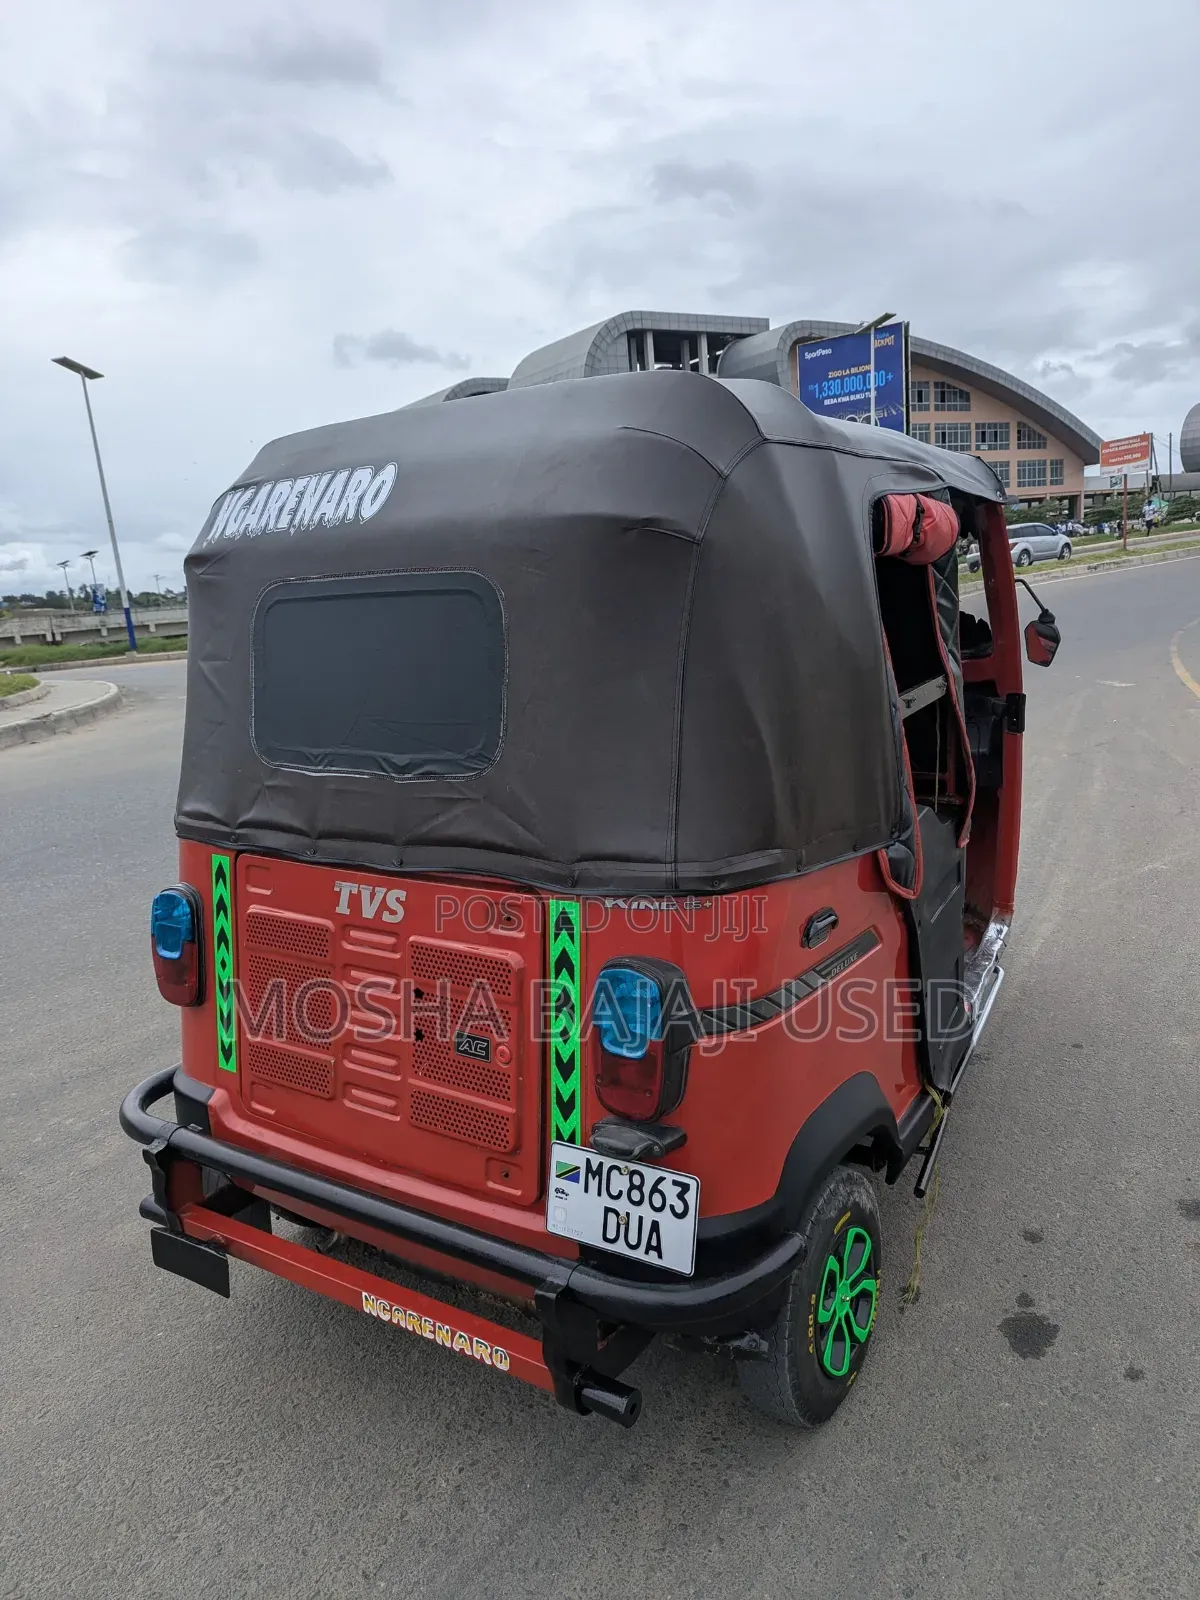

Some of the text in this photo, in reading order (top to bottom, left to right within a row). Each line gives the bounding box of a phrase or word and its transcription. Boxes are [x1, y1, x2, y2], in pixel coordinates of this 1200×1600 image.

[873, 335, 895, 348] ACKPOT
[828, 370, 842, 379] ZIGO
[843, 368, 850, 376] LA
[824, 397, 838, 405] BEBA
[837, 395, 850, 403] KWA
[850, 392, 865, 401] BUKU
[203, 461, 398, 548] NGARENARO
[333, 880, 407, 923] TVS
[831, 951, 860, 977] DELUXE
[457, 1038, 488, 1057] AC
[583, 1157, 691, 1220] MC863
[602, 1205, 663, 1260] DUA
[361, 1291, 510, 1372] NGARENARO
